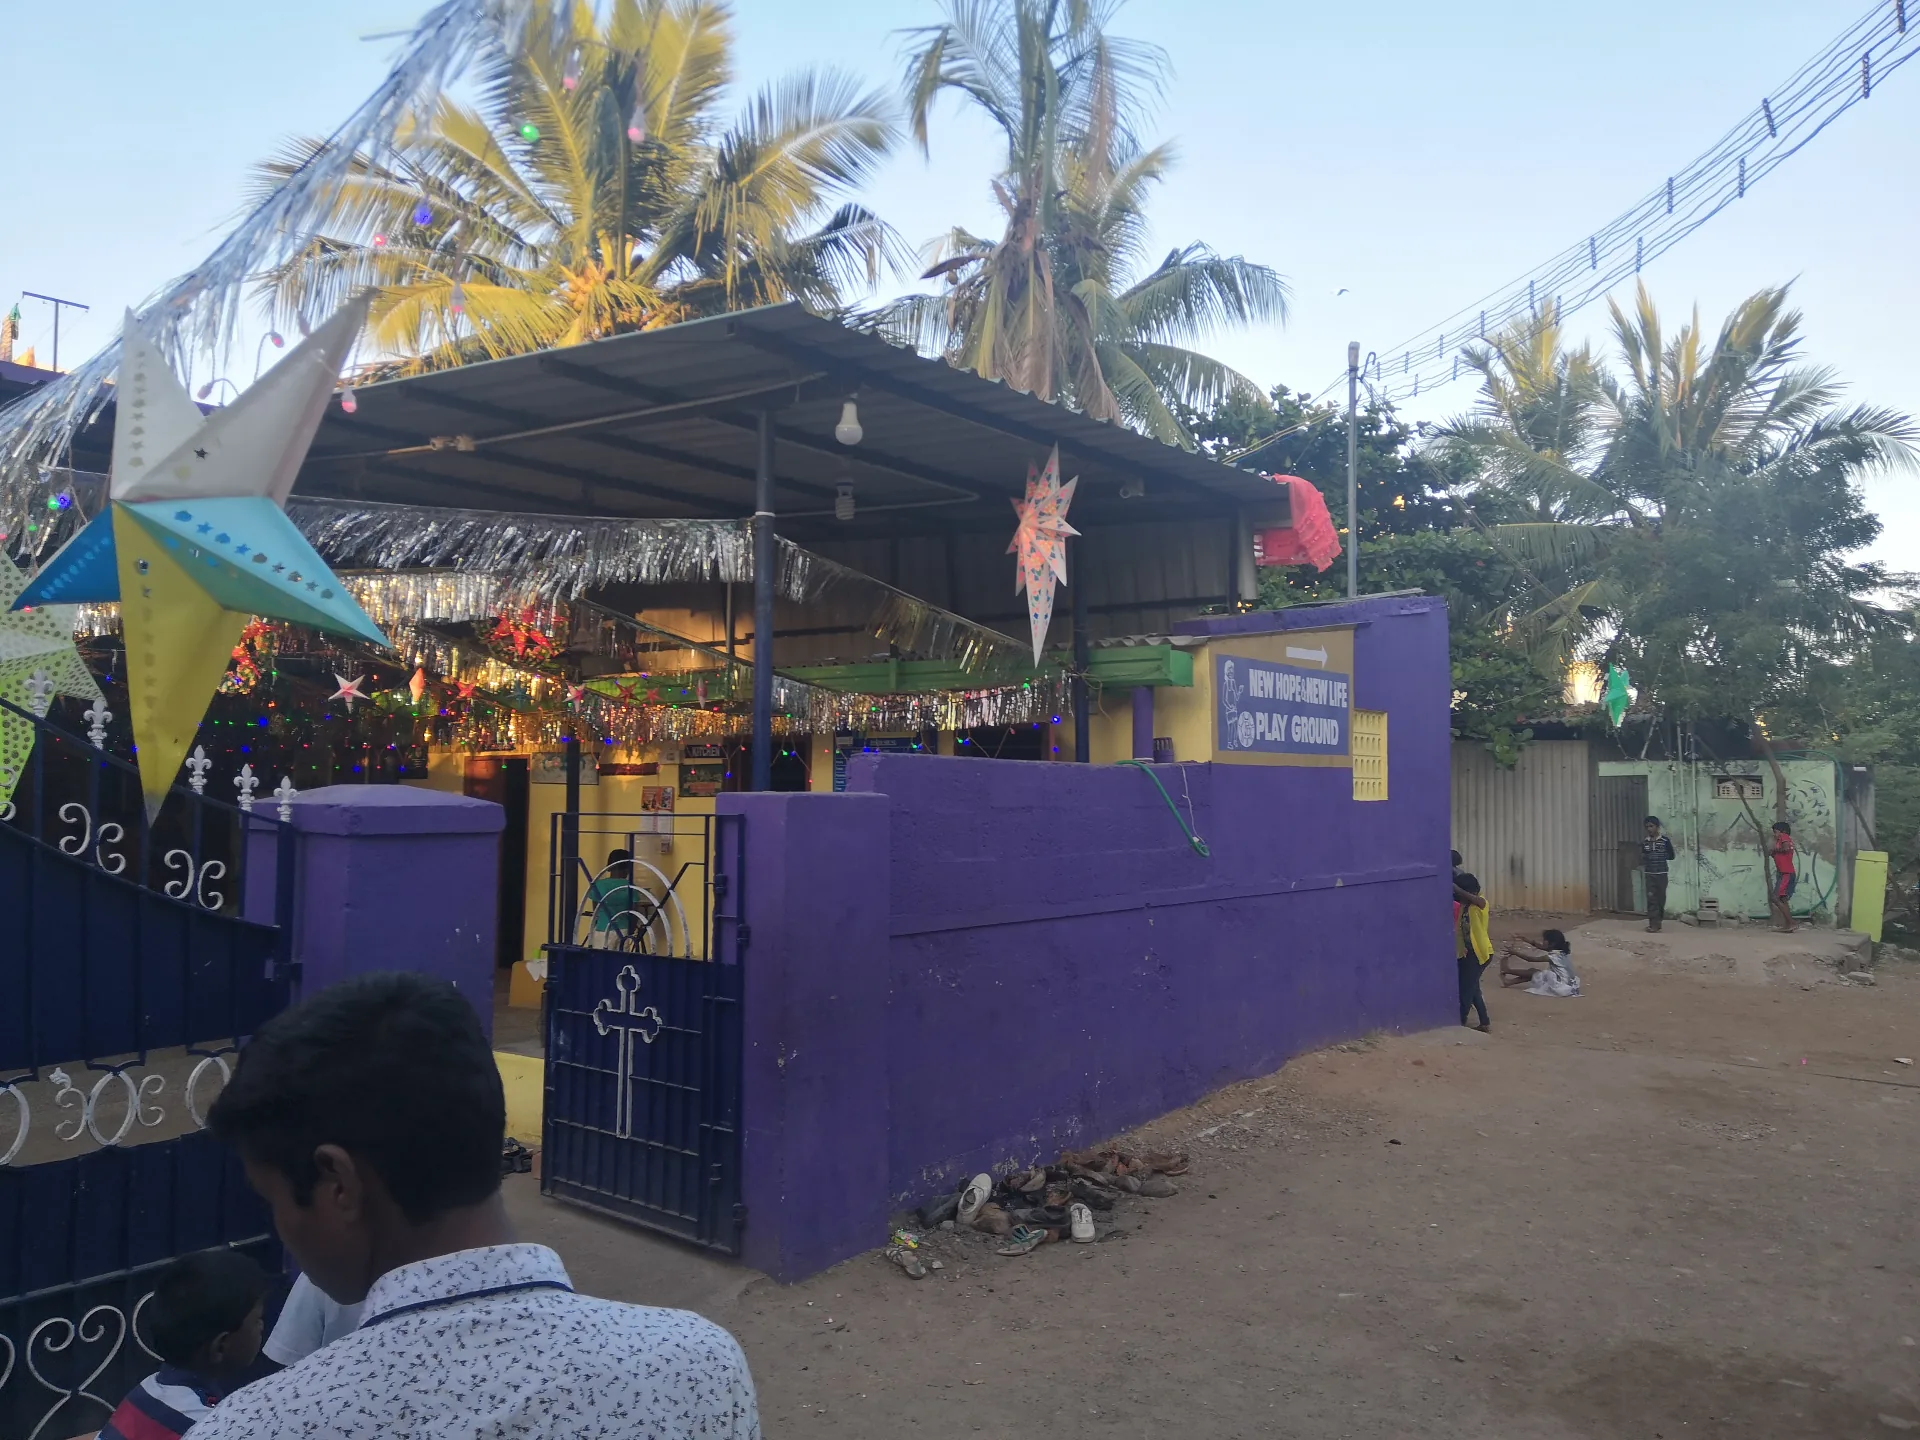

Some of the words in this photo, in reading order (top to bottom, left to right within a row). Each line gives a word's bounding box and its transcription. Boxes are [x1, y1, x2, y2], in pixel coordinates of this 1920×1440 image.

[1249, 668, 1274, 698] NEW
[1329, 680, 1347, 708] LIFE
[1255, 711, 1288, 741] PLAY
[1291, 715, 1339, 745] GROUND
